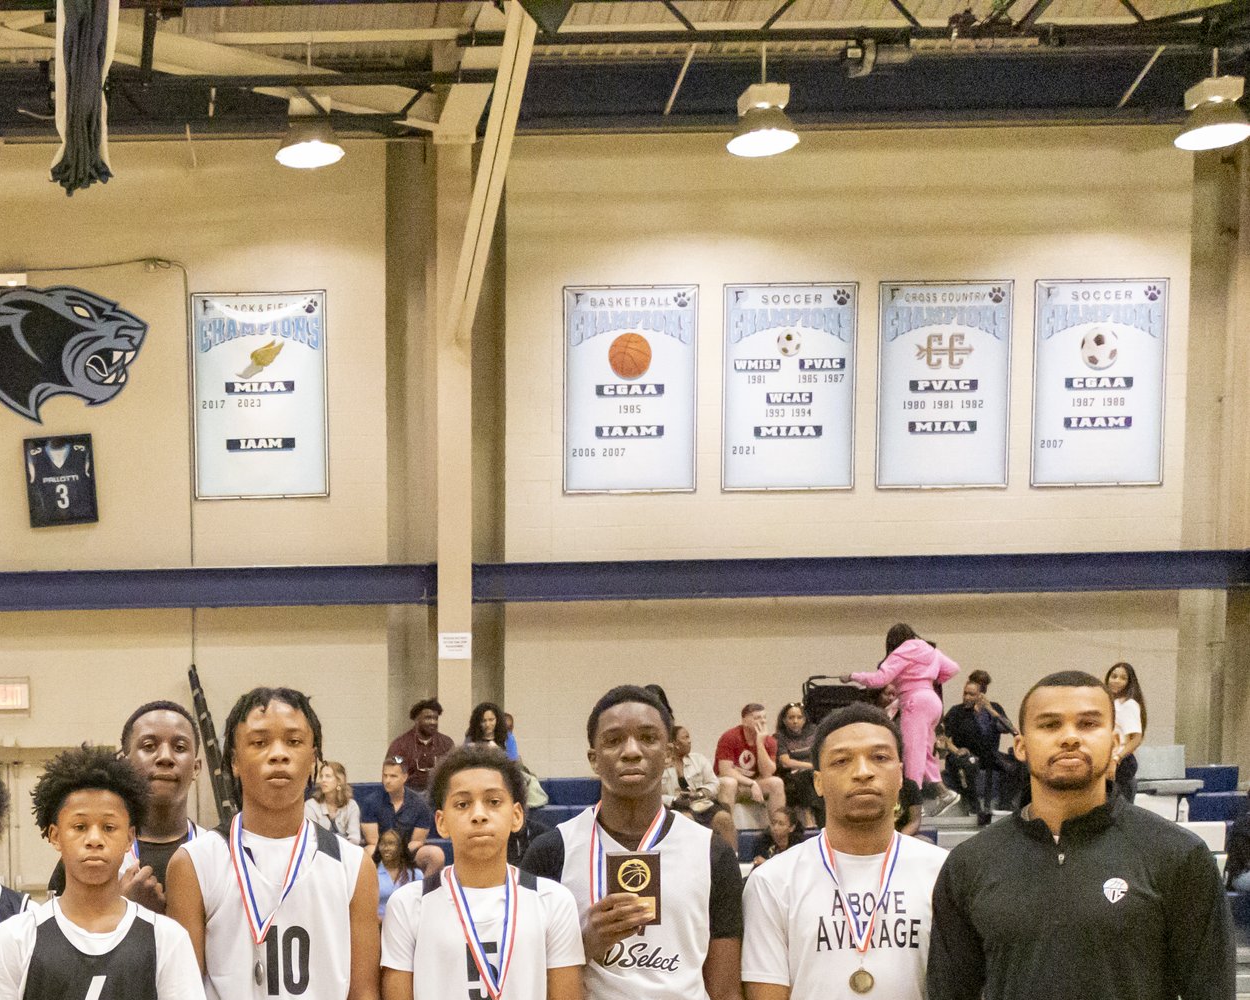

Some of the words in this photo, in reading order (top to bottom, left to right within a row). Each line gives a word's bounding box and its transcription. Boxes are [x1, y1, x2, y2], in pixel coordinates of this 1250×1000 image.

[761, 294, 824, 304] SOCCER
[905, 292, 938, 303] CROSS
[941, 291, 987, 302] COUNTRY
[1071, 290, 1133, 301] SOCCER
[589, 296, 672, 307] BASKETBALL
[200, 316, 319, 353] CHAMPIONS
[734, 360, 781, 371] WMISL
[804, 359, 842, 369] PVAC
[824, 373, 845, 383] 1987
[1072, 377, 1126, 388] CGAA
[234, 381, 287, 392] MIAA
[602, 385, 658, 395] CGAA
[917, 381, 971, 391] PVAC
[769, 392, 811, 403] WCAC
[1072, 397, 1095, 407] 1987
[1102, 397, 1126, 407] 1988
[202, 400, 226, 410] 2017
[237, 398, 262, 408] 2023
[618, 404, 641, 414] 1985
[902, 400, 926, 410] 1980
[933, 400, 953, 410] 1981
[961, 399, 984, 409] 1982
[915, 421, 971, 432] MIAA
[1070, 417, 1126, 428] IAAM
[601, 426, 658, 437] IAAM
[760, 426, 816, 437] MIAA
[239, 438, 283, 449] IAAM
[1040, 439, 1064, 449] 2007
[571, 448, 596, 458] 2006
[602, 448, 626, 457] 2007
[732, 446, 756, 455] 2021
[42, 474, 79, 483] PALLOTTI
[55, 484, 70, 509] 3
[263, 925, 311, 996] 10
